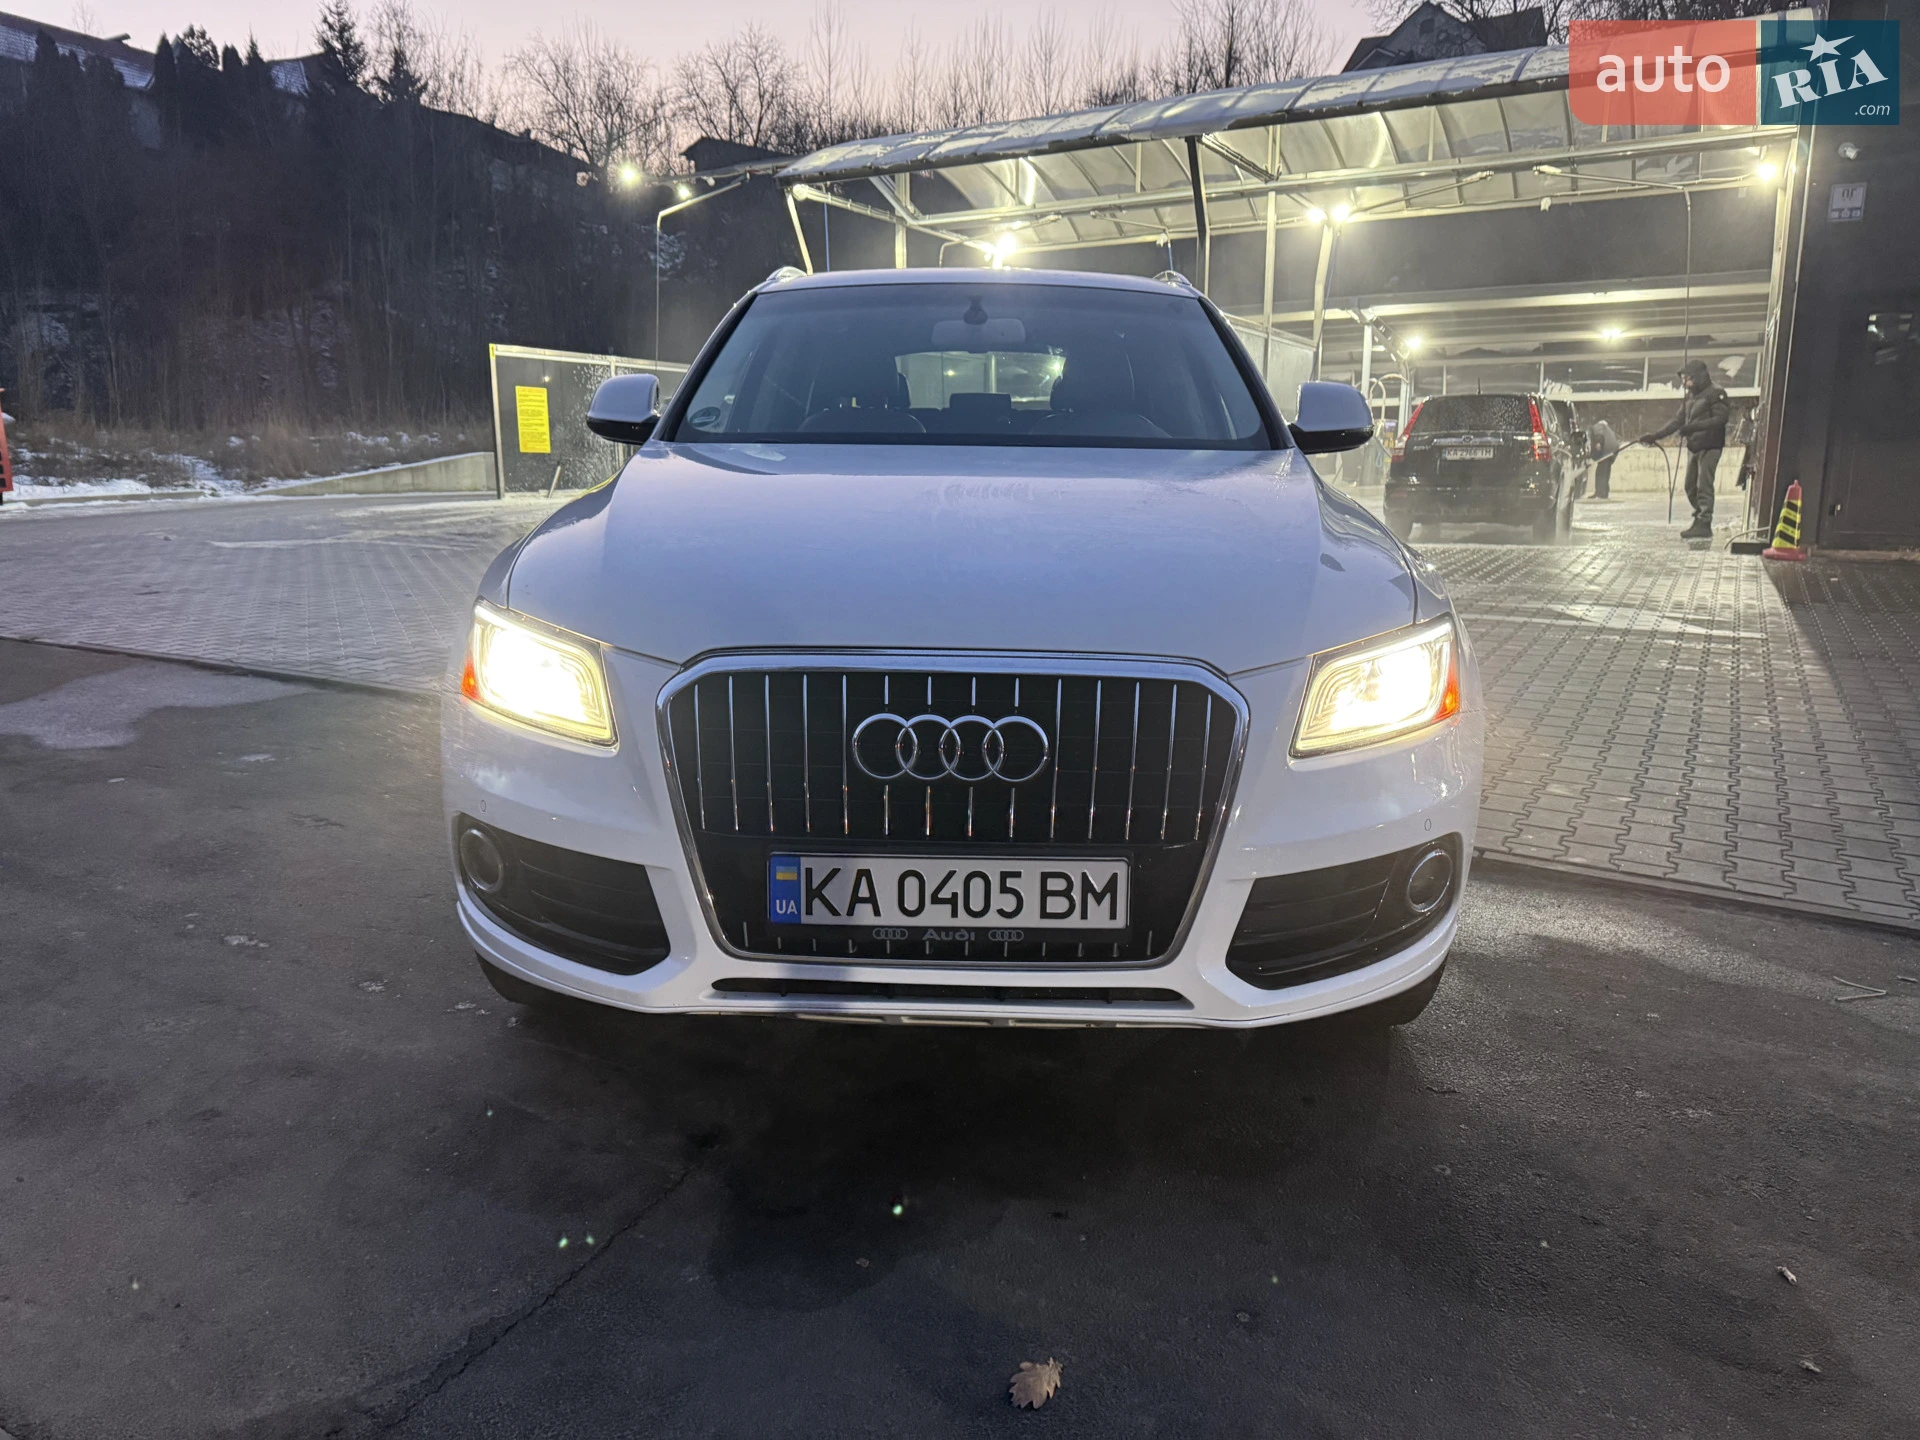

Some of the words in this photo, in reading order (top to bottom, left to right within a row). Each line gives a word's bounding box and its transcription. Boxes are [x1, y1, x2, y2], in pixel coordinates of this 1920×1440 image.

[804, 867, 881, 918] KA
[896, 869, 1024, 919] 0405
[1039, 871, 1119, 921] BM
[775, 900, 798, 915] UA
[921, 928, 976, 942] Audi
